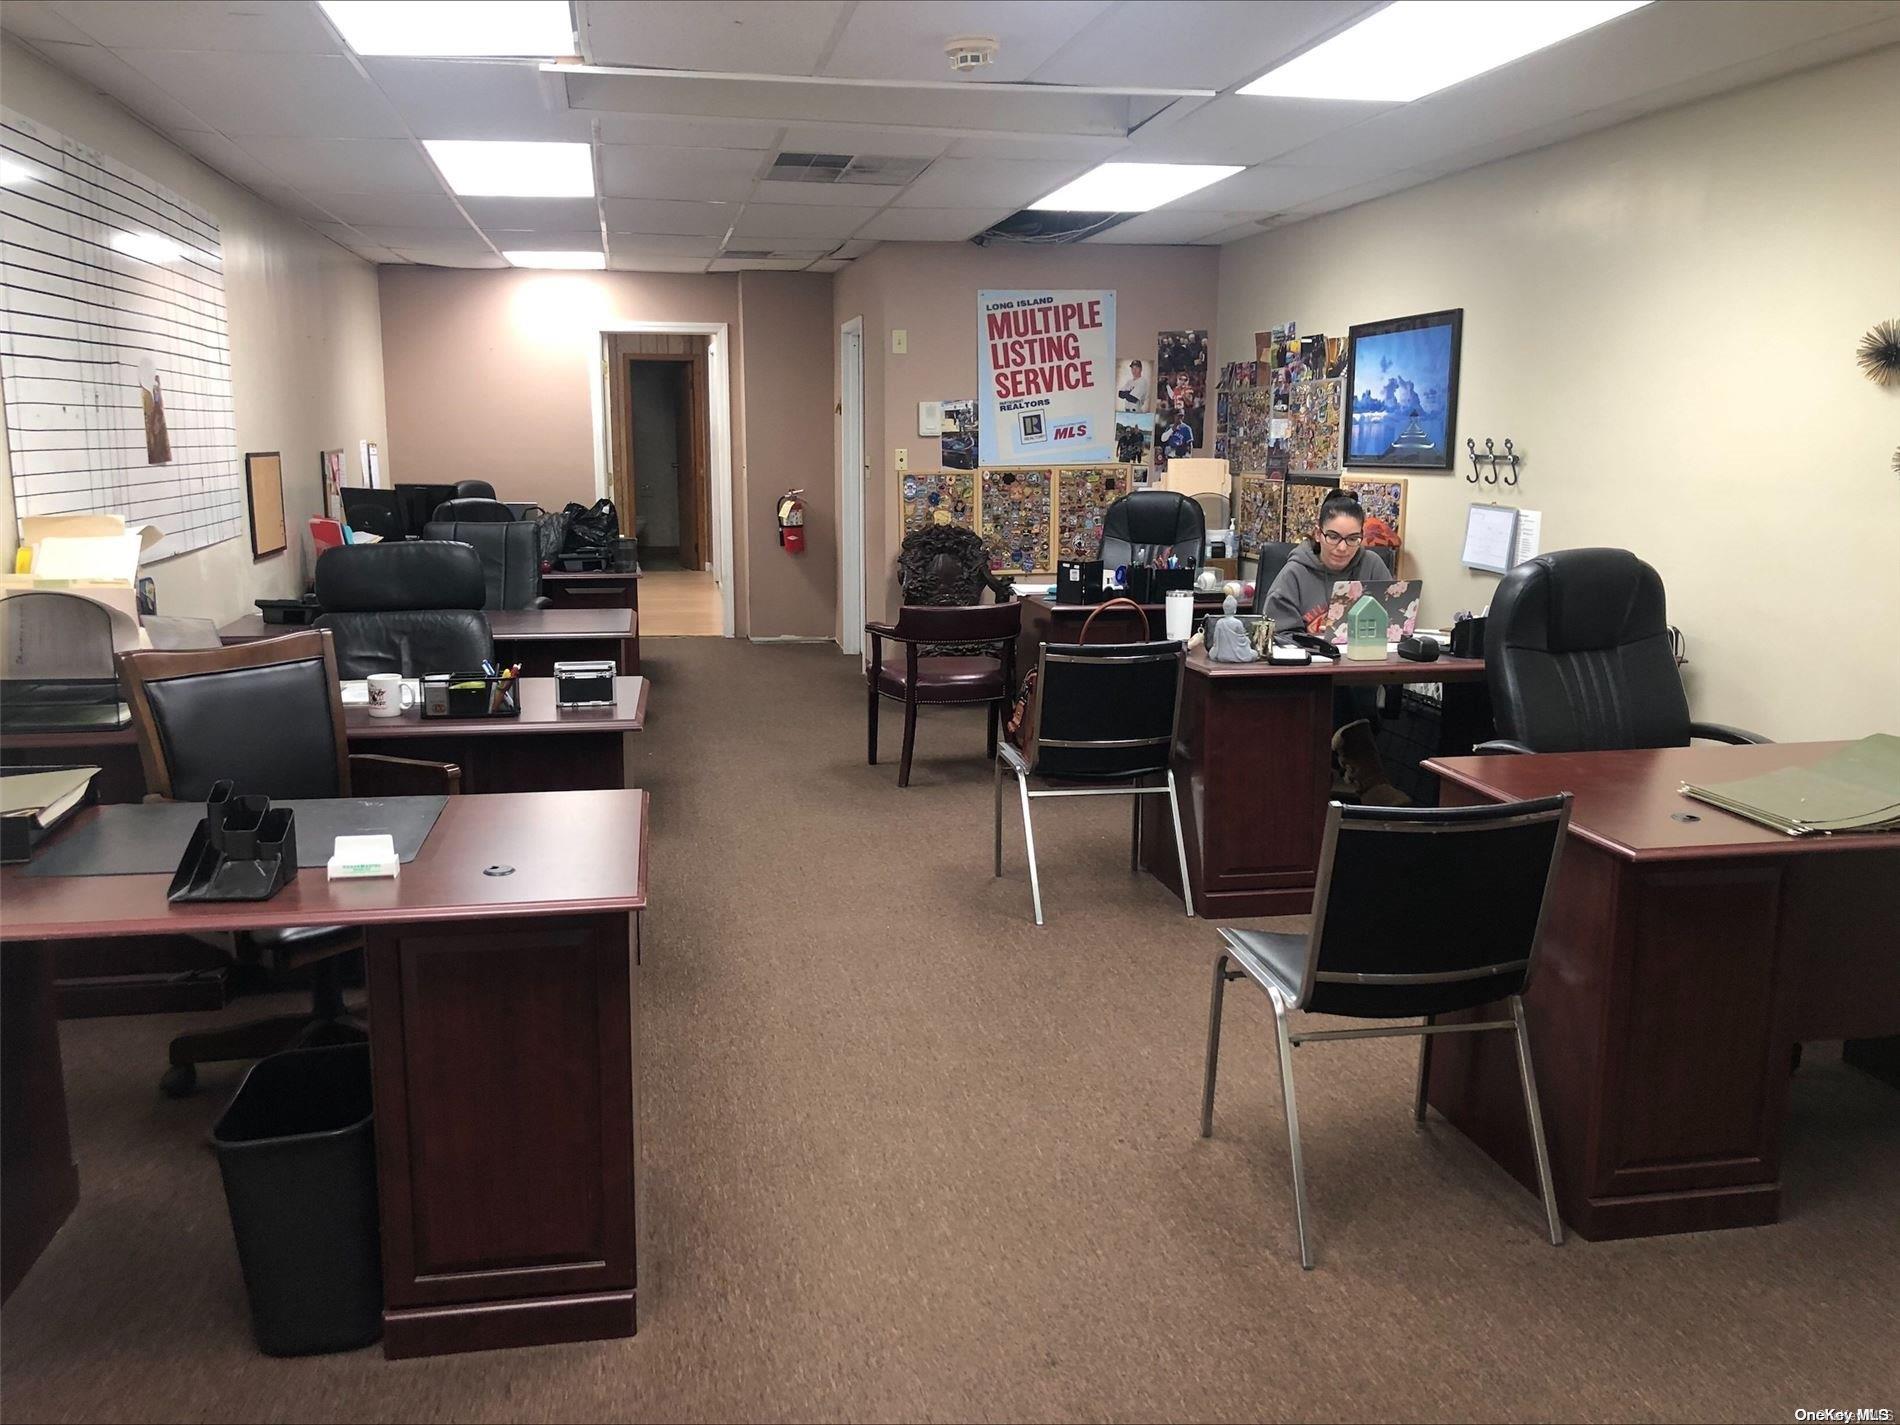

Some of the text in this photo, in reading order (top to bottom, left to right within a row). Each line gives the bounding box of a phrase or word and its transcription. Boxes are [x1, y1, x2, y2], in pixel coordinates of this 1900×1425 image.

[986, 297, 1054, 311] LONG ISLAND
[987, 300, 1103, 341] MULTIPLE
[991, 333, 1080, 370] LISTING
[995, 360, 1094, 399] SERVICE
[1000, 398, 1050, 412] REALTORS
[1054, 424, 1087, 440] MLS
